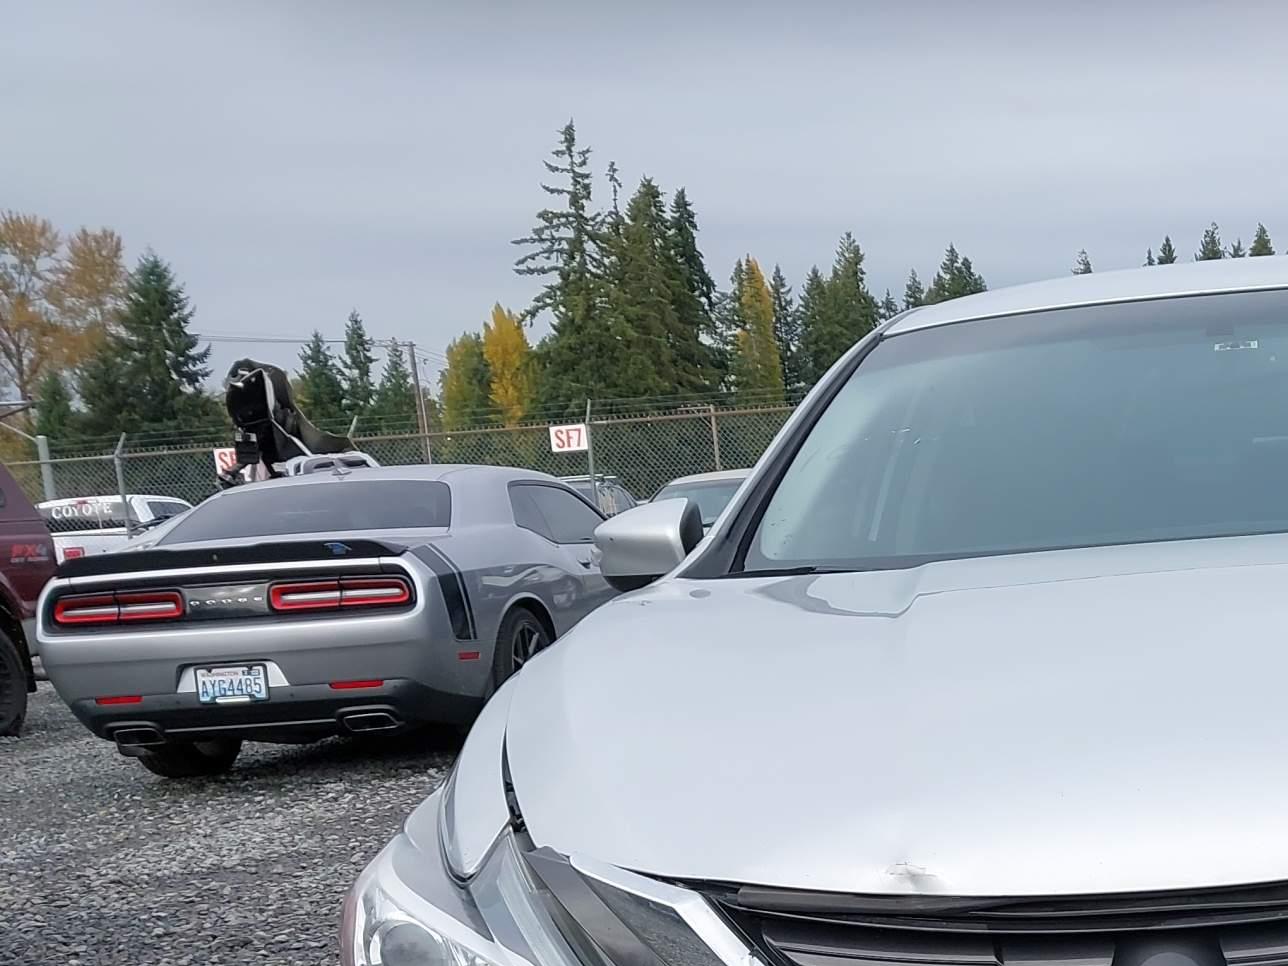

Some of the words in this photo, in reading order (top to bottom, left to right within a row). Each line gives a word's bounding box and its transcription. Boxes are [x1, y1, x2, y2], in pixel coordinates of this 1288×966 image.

[554, 428, 581, 449] SF7
[51, 502, 113, 519] COYOTE
[201, 677, 262, 698] AYG4485
